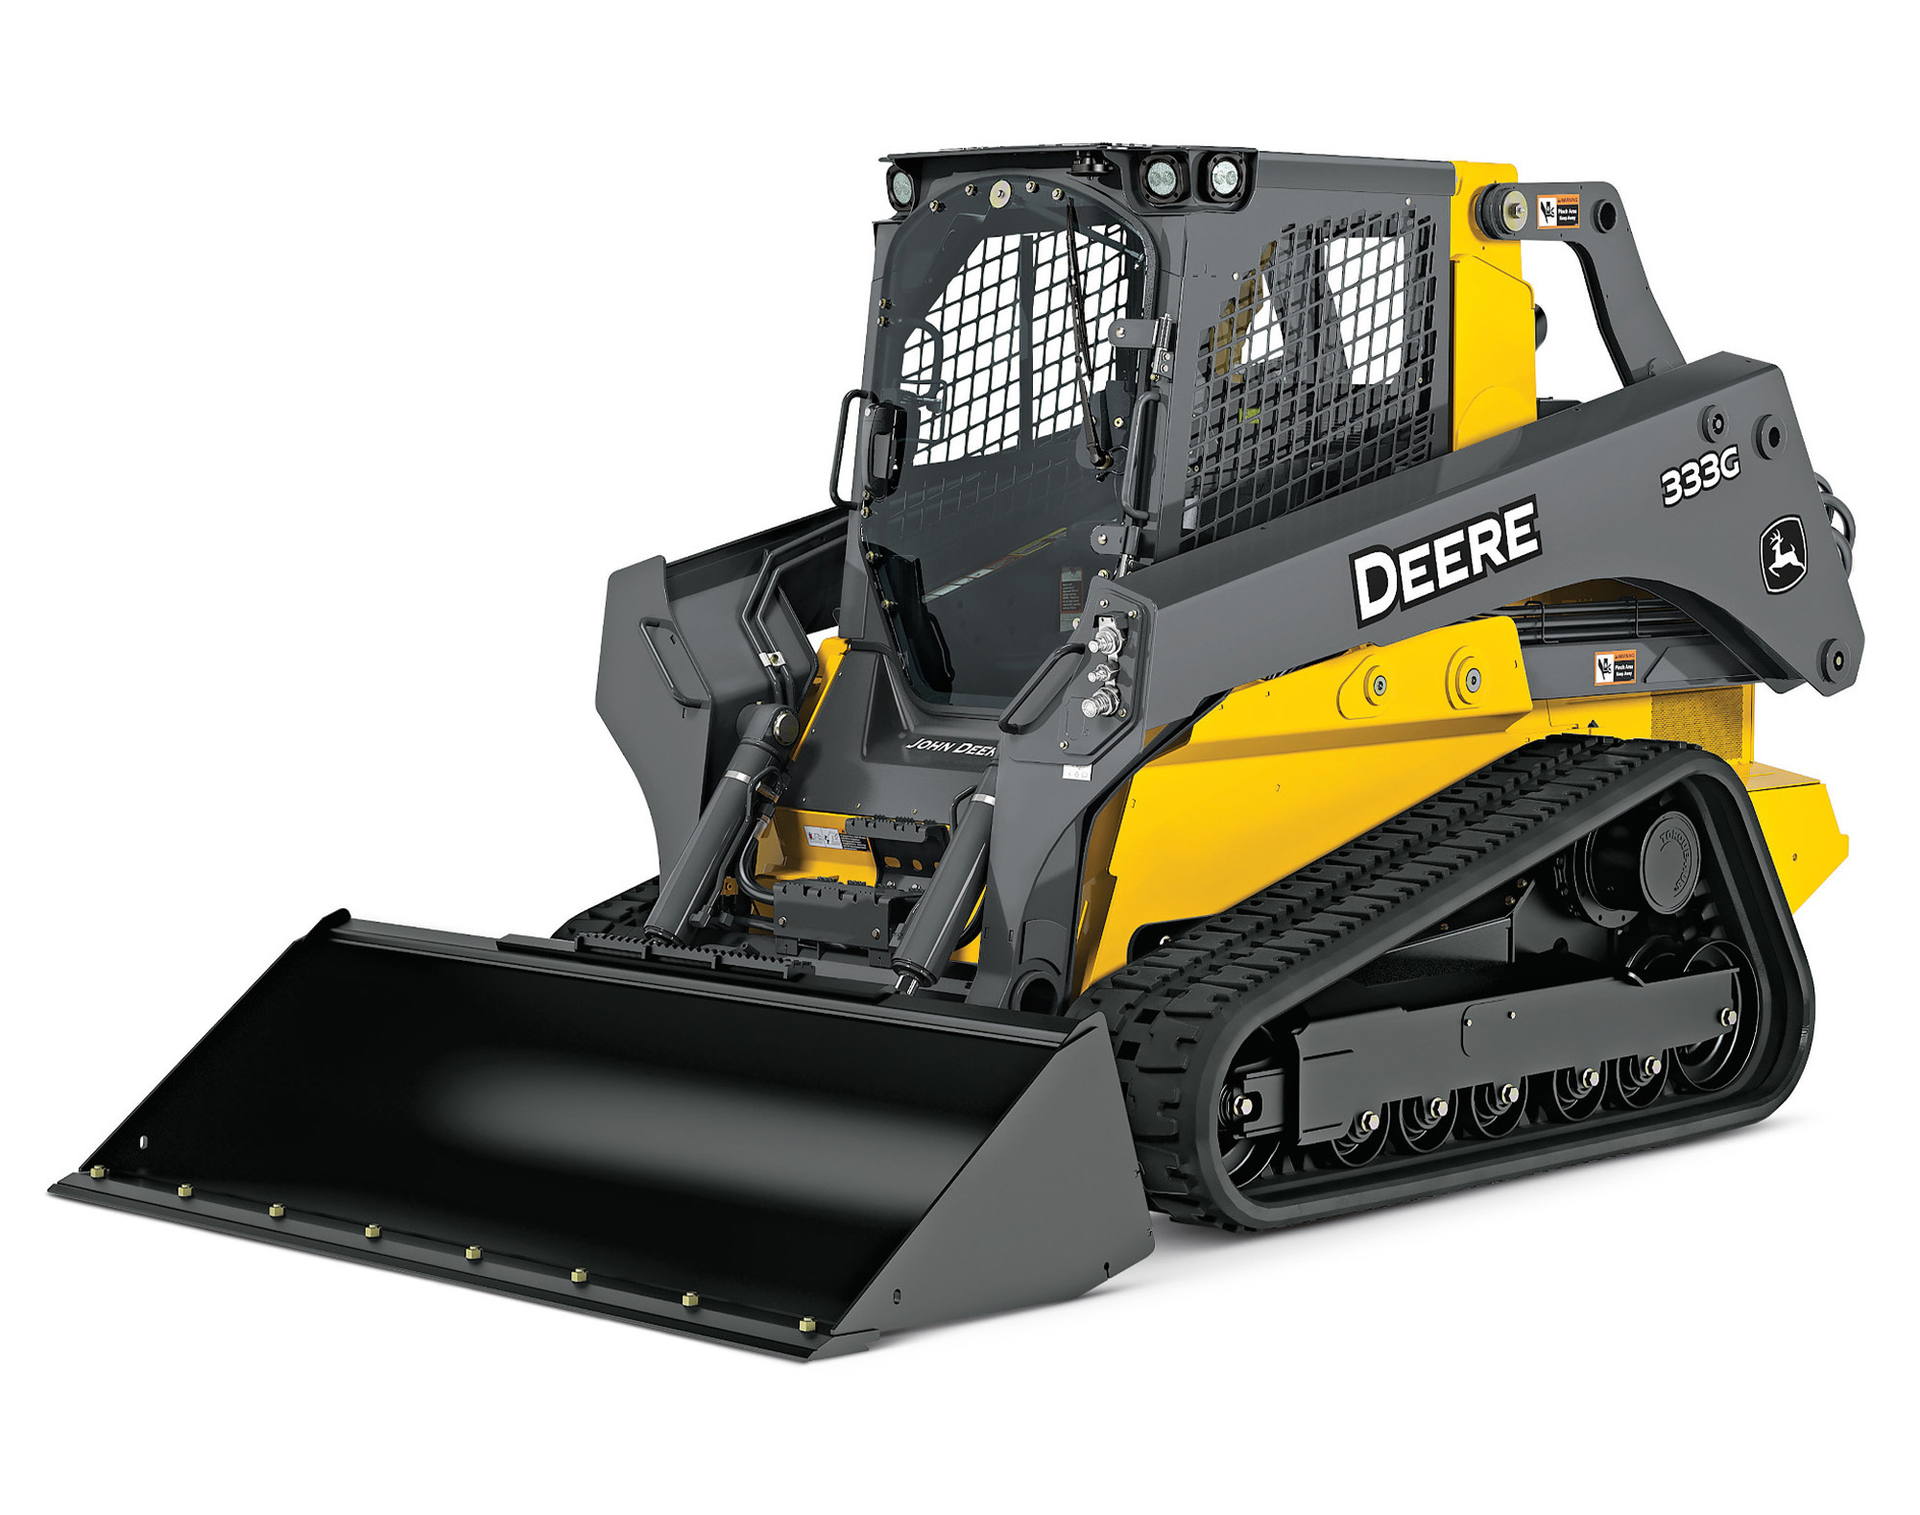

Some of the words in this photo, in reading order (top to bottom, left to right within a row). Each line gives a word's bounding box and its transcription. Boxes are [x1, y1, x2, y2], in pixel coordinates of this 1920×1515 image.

[1661, 446, 1740, 506] 333G
[1353, 501, 1539, 621] DEERE
[906, 738, 956, 752] JOHN
[952, 742, 997, 757] DEER
